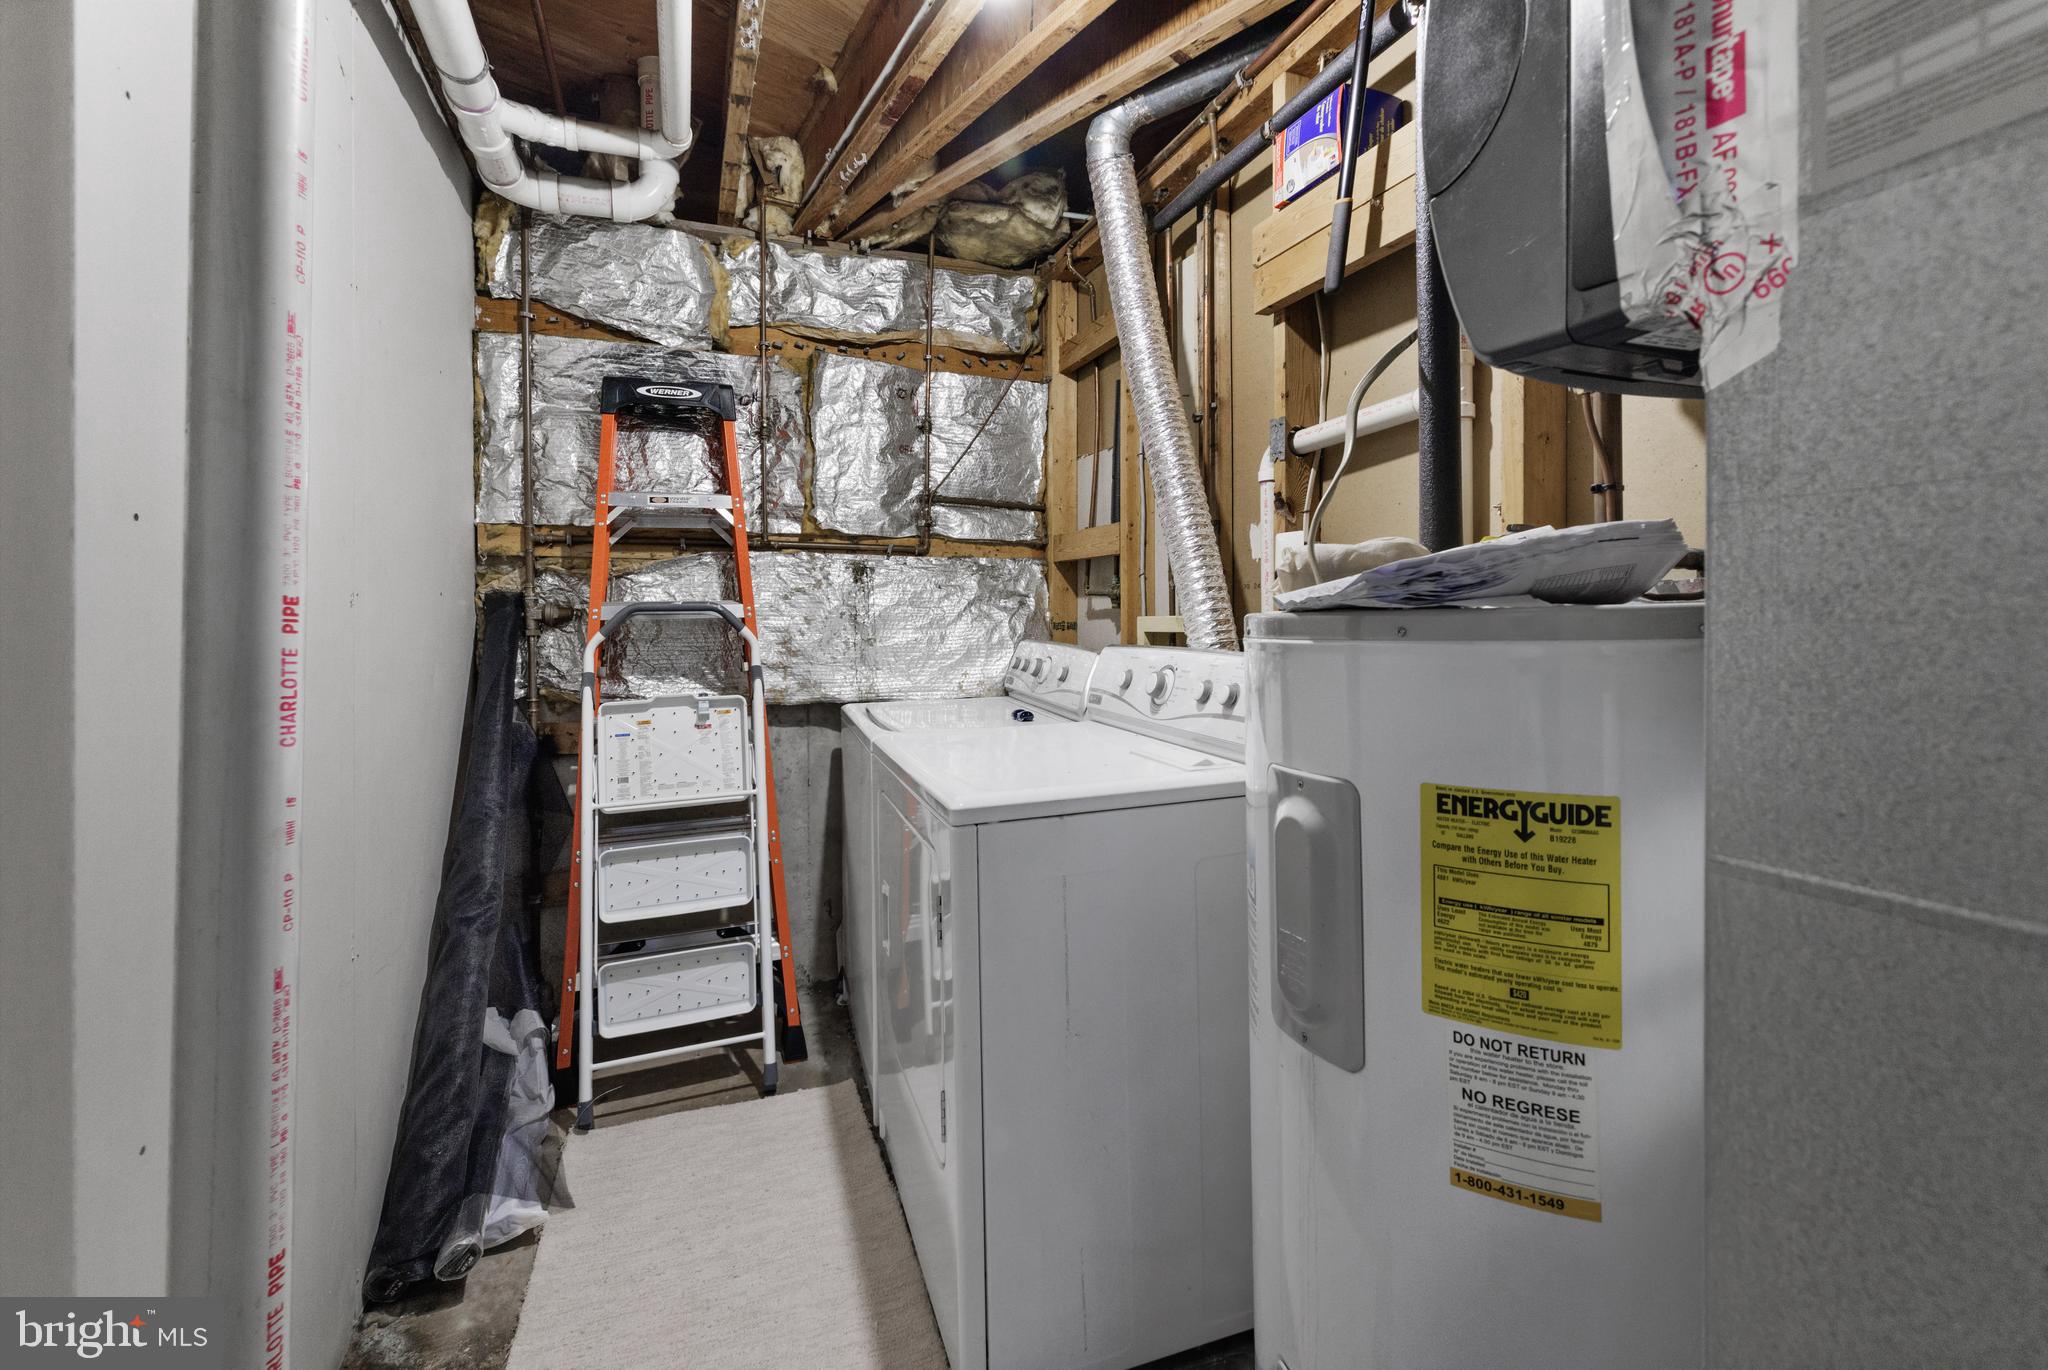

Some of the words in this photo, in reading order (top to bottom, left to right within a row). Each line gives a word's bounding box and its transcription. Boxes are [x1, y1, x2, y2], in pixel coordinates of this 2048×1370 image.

[1674, 1, 1697, 80] 181A-P
[1674, 103, 1700, 201] 181B-FX
[1711, 131, 1738, 161] AF
[650, 387, 690, 396] WERNER
[281, 595, 299, 634] PIPE
[279, 649, 297, 748] CHARLOTTE
[1437, 793, 1612, 828] ENERGYGUIDE
[1432, 840, 1461, 852] Compare
[1464, 845, 1475, 853] the
[1477, 847, 1501, 858] Energy
[1504, 850, 1518, 858] Use
[1530, 852, 1544, 861] this
[1547, 854, 1569, 863] Water
[1572, 856, 1597, 865] Heater
[1479, 856, 1501, 867] Others
[1505, 860, 1528, 870] Before
[1532, 863, 1545, 872] You
[1548, 865, 1564, 875] Buy.
[1453, 1030, 1475, 1046] DO
[1480, 1036, 1512, 1054] NOT
[1518, 1044, 1585, 1066] RETURN
[1462, 1087, 1487, 1104] NO
[1493, 1095, 1581, 1123] REGRESE
[1455, 1172, 1565, 1210] 1-800-431-1549
[267, 1249, 287, 1297] PIPE
